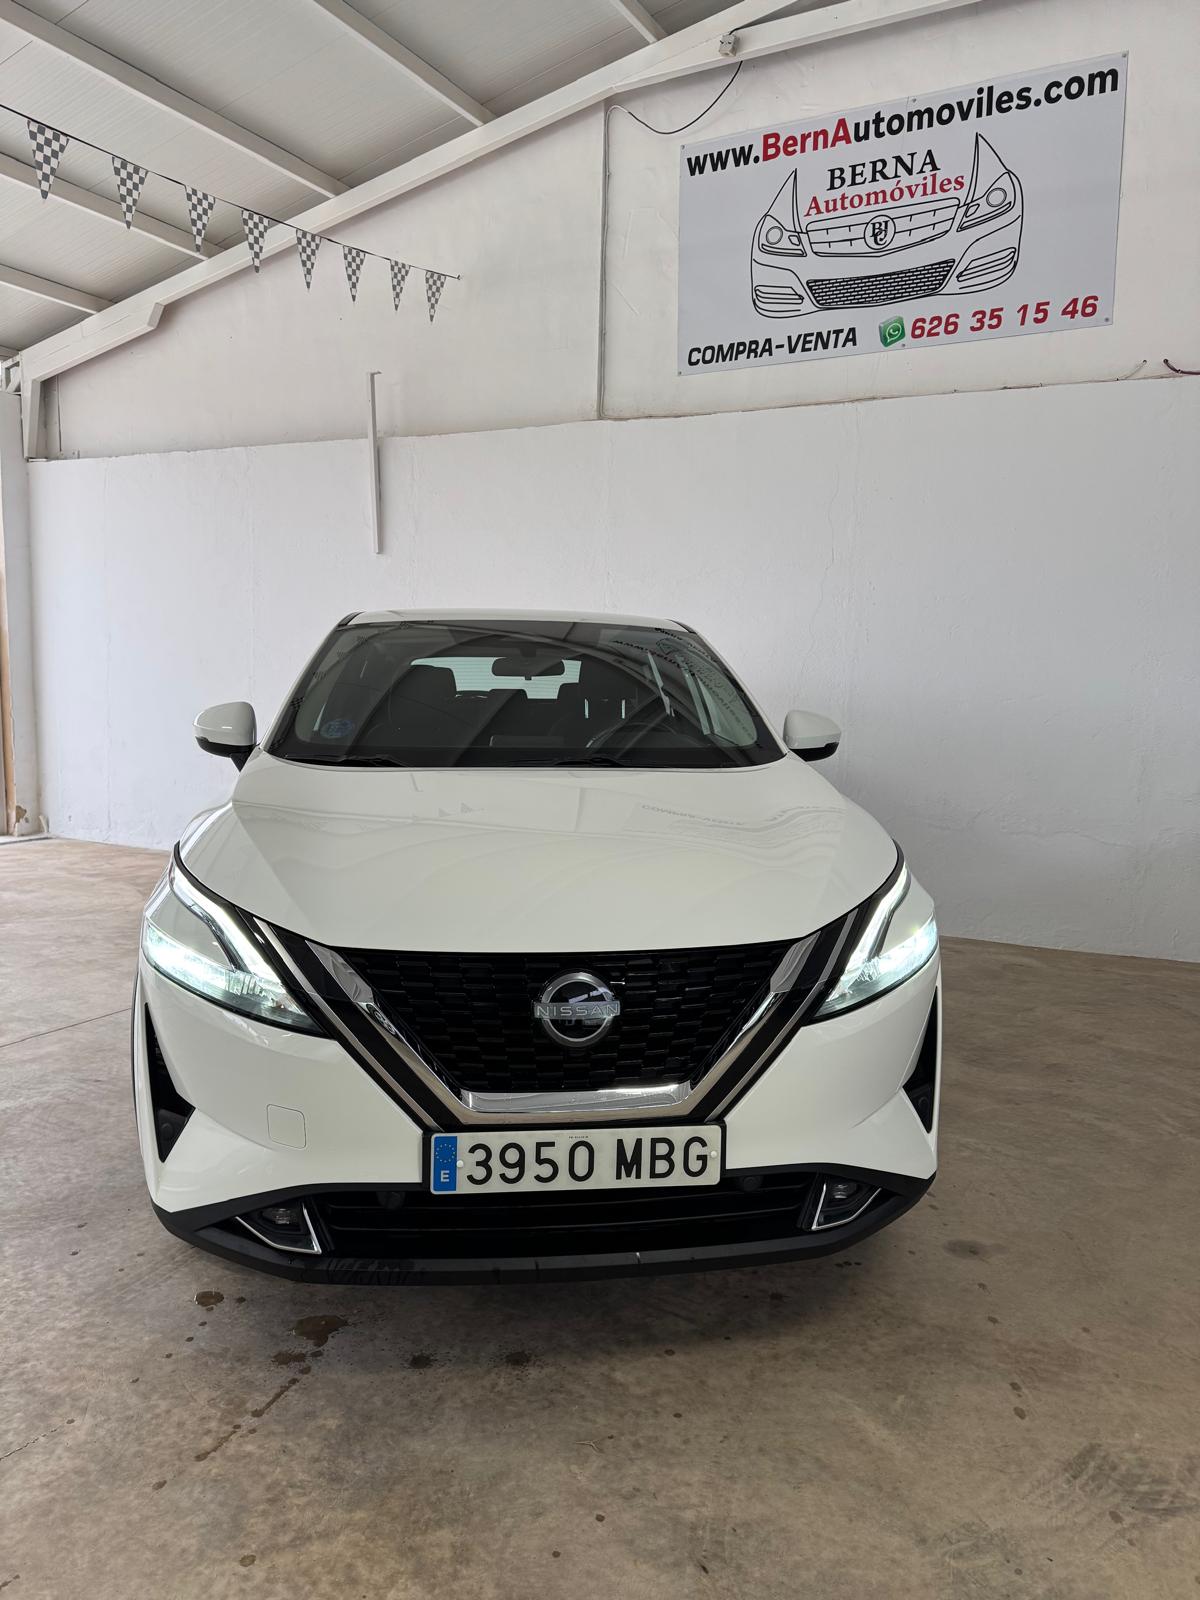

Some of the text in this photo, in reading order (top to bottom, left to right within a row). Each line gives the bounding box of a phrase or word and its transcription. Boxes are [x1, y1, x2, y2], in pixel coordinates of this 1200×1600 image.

[686, 68, 1119, 177] www.BernAutomoviles.com
[826, 149, 941, 192] BERNA
[803, 174, 965, 218] Automóviles
[910, 295, 1099, 339] 626 35 15 46
[687, 326, 857, 367] COMPRA-VENTA
[536, 1003, 618, 1017] NISSAN
[440, 1170, 450, 1182] E
[466, 1135, 709, 1186] 3950 MBG
